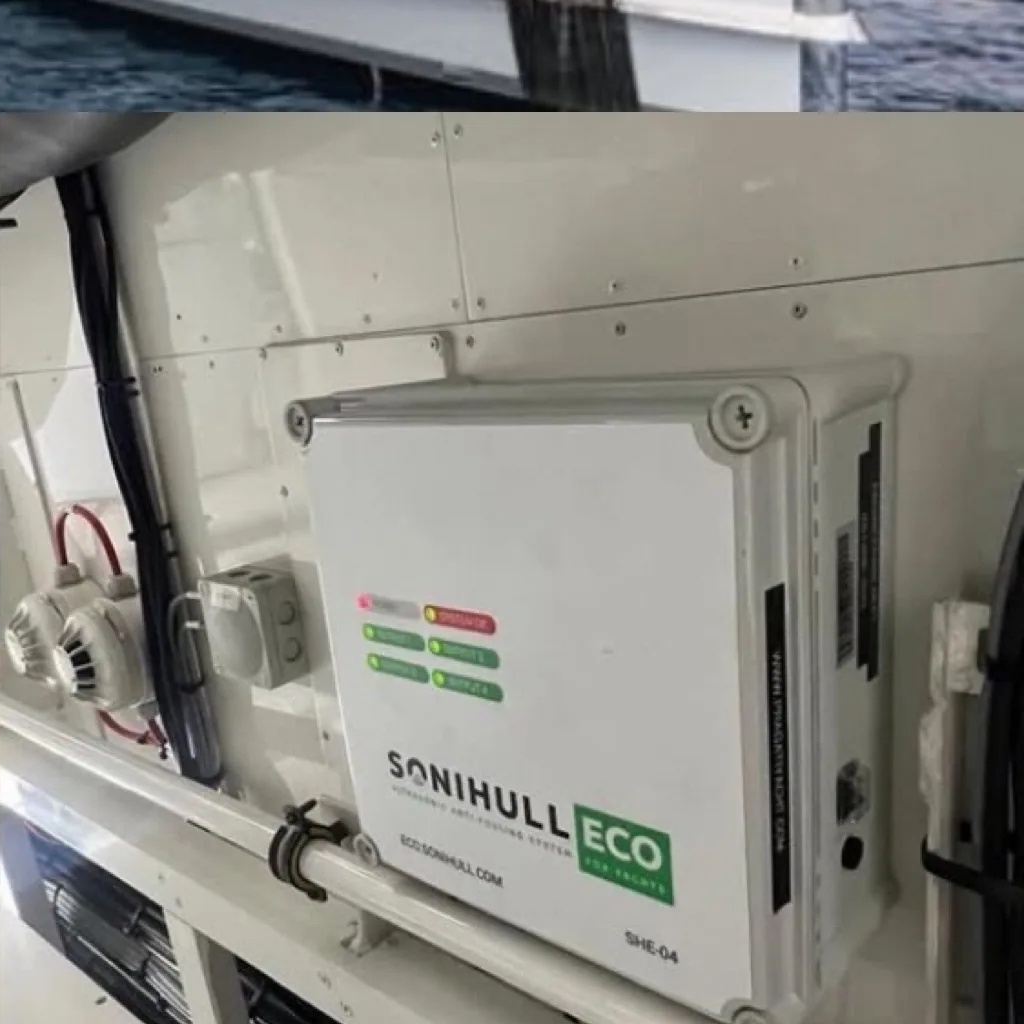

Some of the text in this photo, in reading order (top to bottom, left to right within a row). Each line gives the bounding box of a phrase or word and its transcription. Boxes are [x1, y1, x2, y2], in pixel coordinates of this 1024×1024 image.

[387, 749, 570, 840] SONIHULL
[581, 815, 663, 871] ECO
[624, 930, 679, 964] SHE-04
